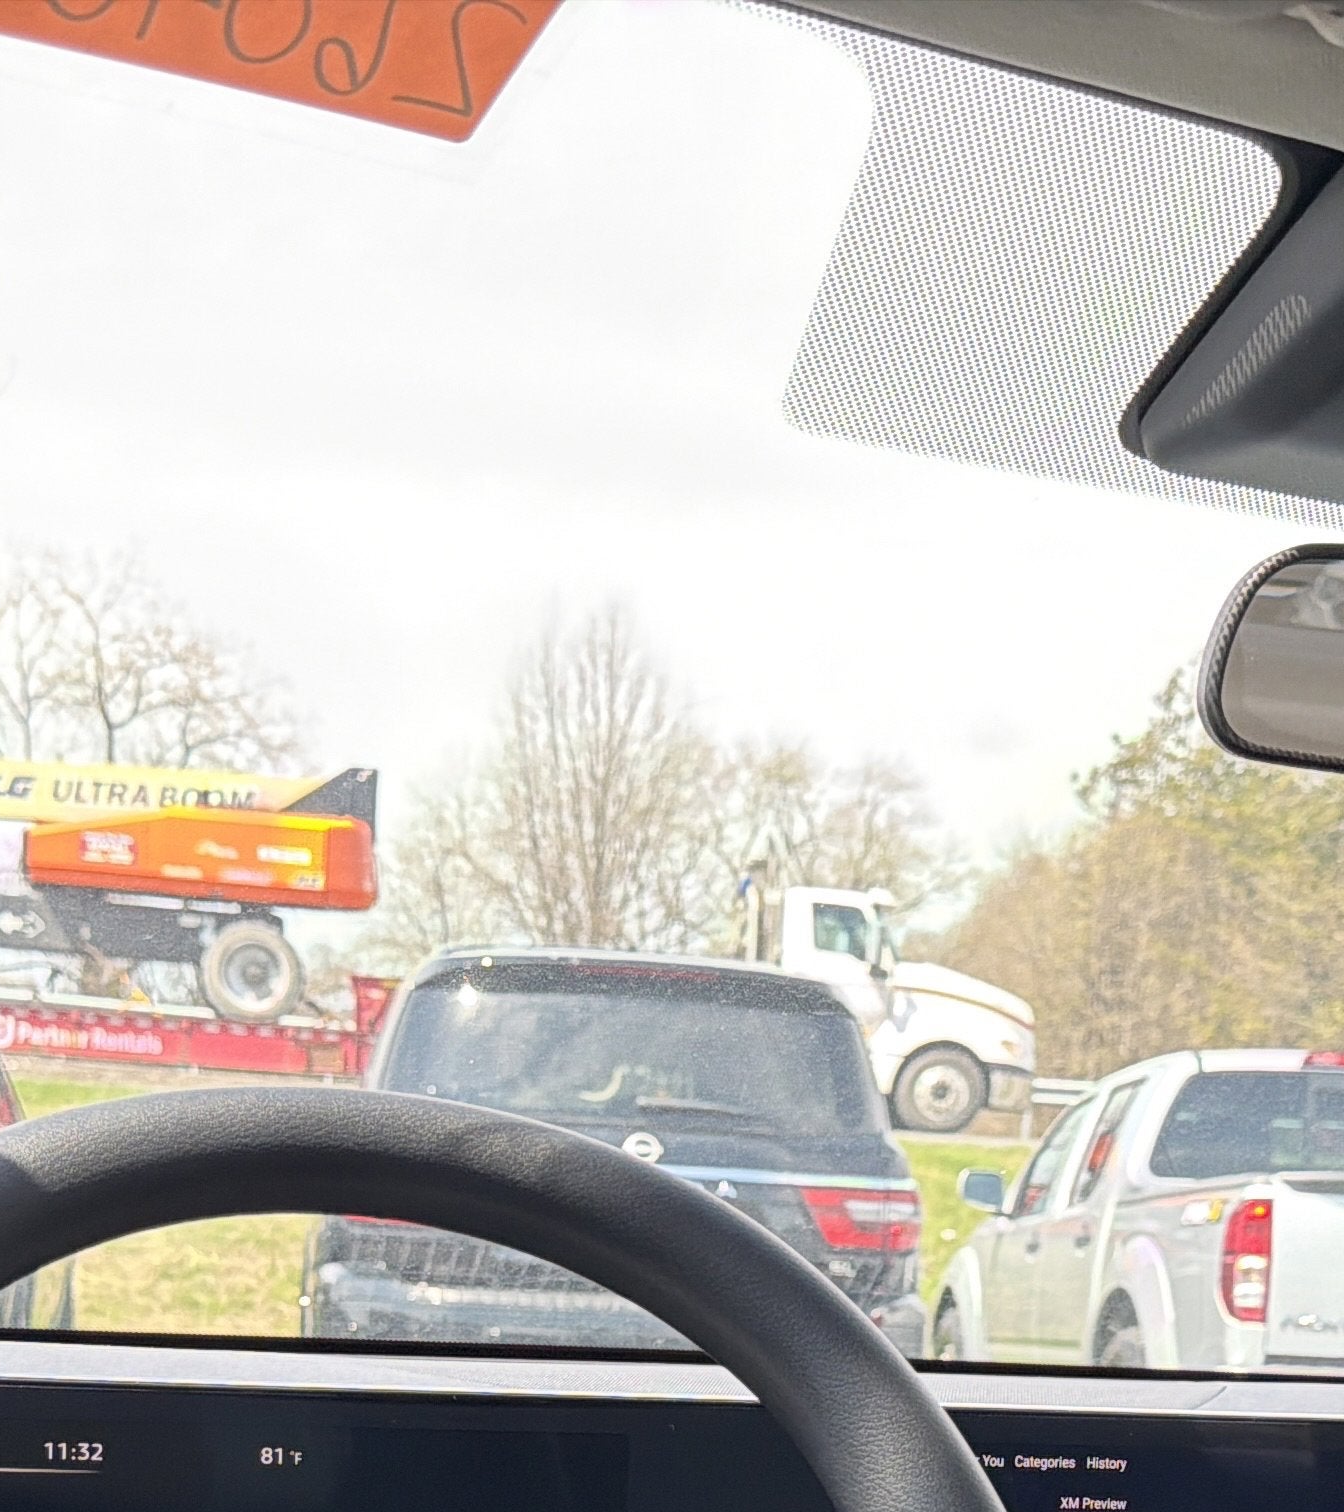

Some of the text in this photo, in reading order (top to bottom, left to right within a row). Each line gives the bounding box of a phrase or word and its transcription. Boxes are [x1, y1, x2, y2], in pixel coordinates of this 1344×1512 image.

[52, 779, 149, 807] ULTRA
[158, 787, 256, 810] BOOM
[44, 1442, 104, 1461] 11:32
[260, 1447, 283, 1465] 81
[982, 1456, 1004, 1467] You
[1014, 1455, 1076, 1471] Categories
[1087, 1457, 1127, 1472] History
[1060, 1497, 1126, 1510] XM Preview
